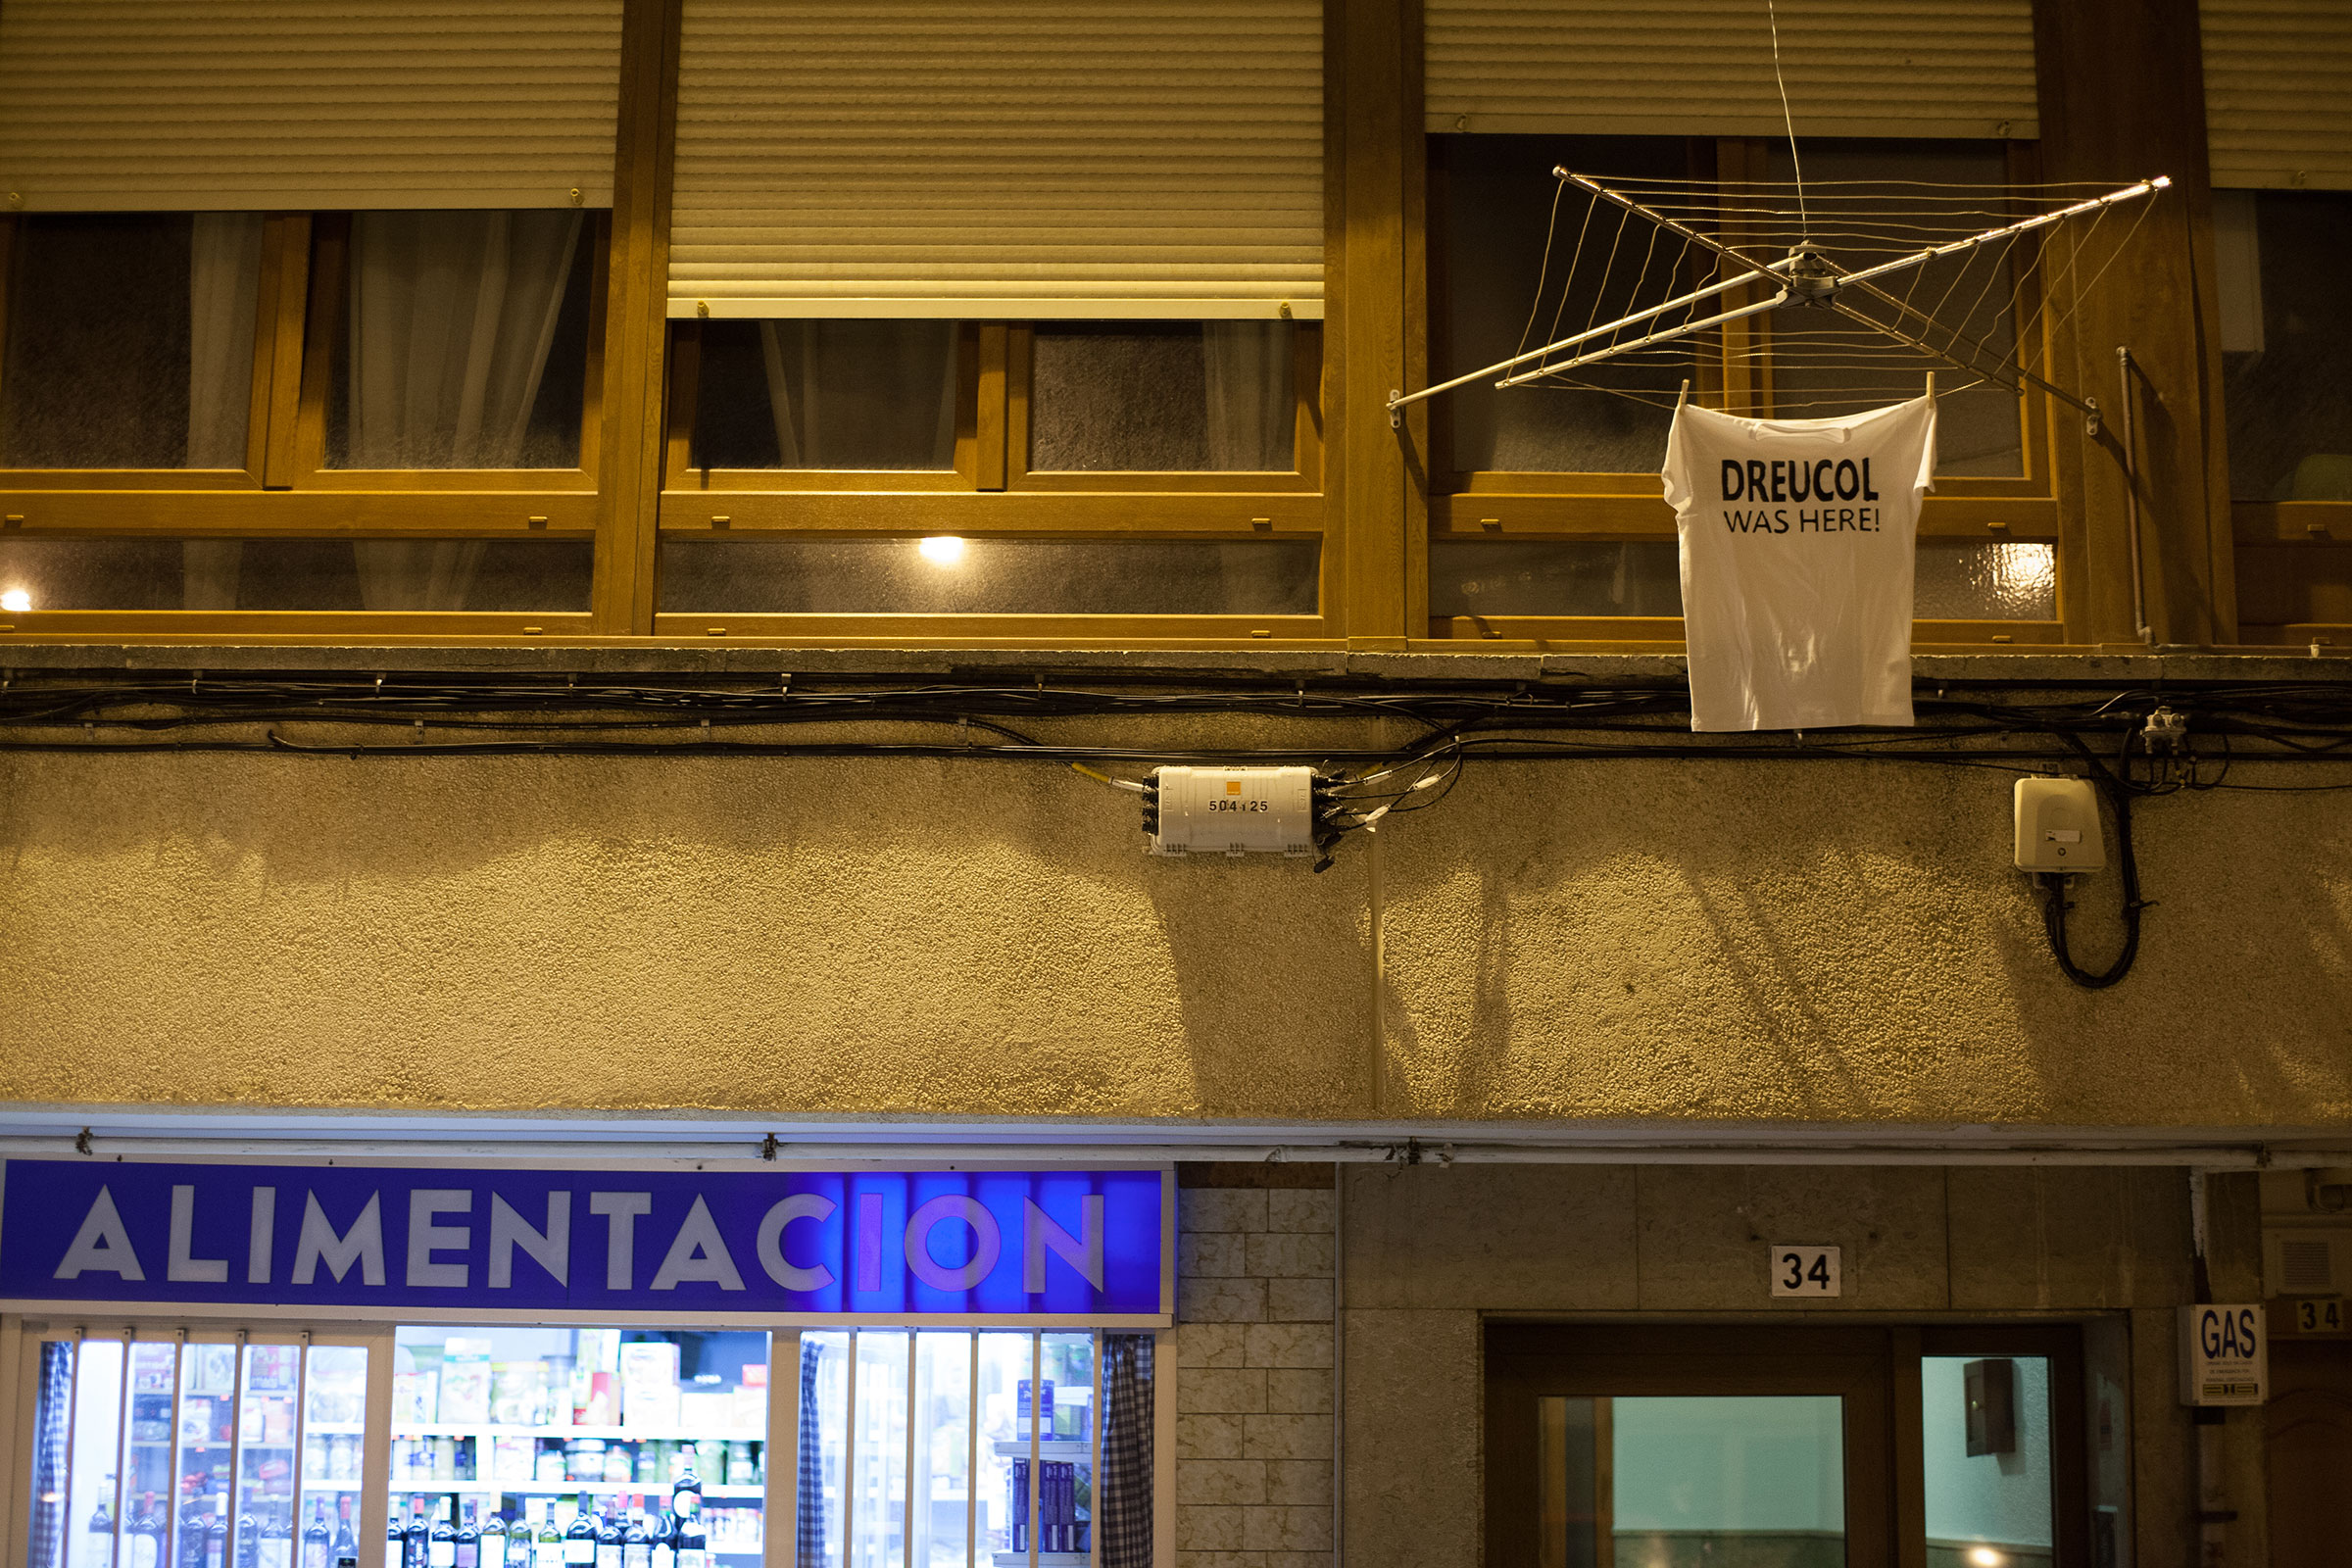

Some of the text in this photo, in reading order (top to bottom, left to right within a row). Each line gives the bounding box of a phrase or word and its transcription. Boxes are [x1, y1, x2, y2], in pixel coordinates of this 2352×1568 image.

[1721, 457, 1880, 503] DREUCOL
[1723, 508, 1881, 534] WAS HERE!
[52, 1183, 1104, 1294] ALIMENTACION
[1782, 1252, 1831, 1290] 34
[2201, 1308, 2256, 1359] GAS
[2301, 1301, 2340, 1330] 34
